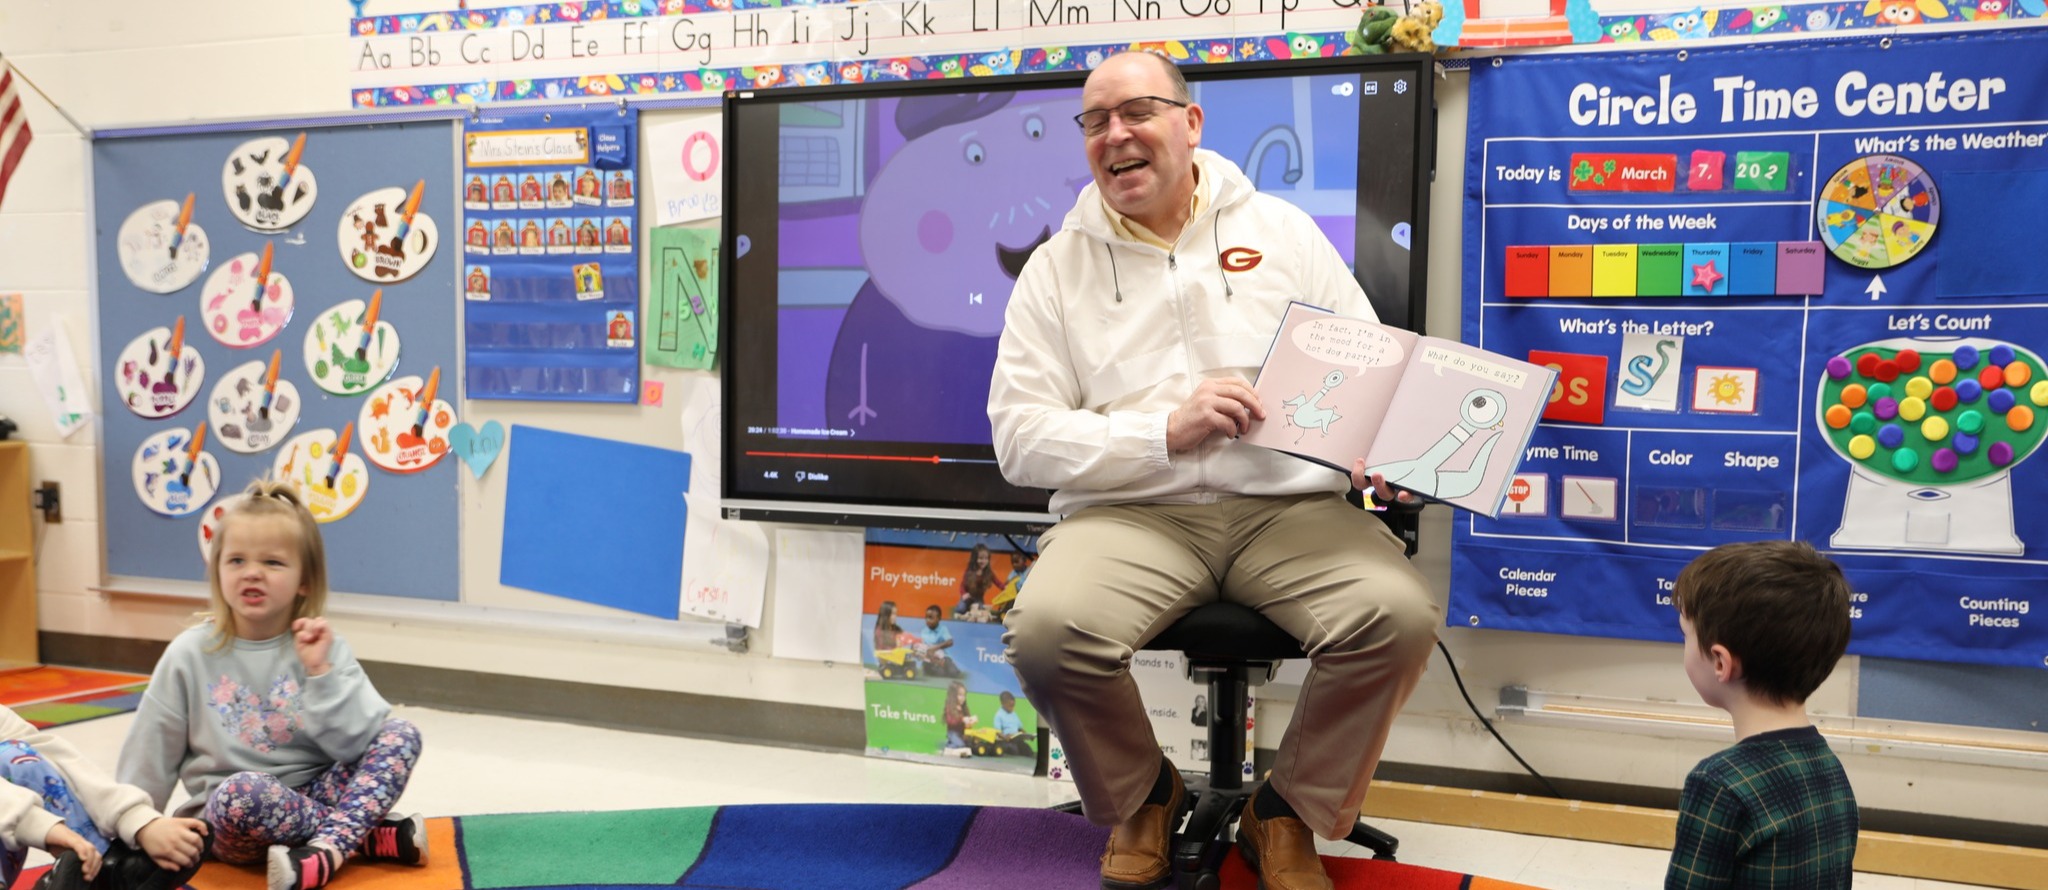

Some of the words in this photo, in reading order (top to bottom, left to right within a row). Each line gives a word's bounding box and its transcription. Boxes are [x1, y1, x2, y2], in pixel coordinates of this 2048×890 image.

[359, 41, 392, 70] Aa
[410, 36, 441, 67] Bb
[460, 33, 491, 64] Cc
[511, 28, 545, 61] Dd
[571, 25, 599, 57] Ee
[623, 21, 648, 54] Ff
[672, 18, 711, 66] Gg
[733, 13, 769, 47] Hh
[791, 9, 810, 43] Ii
[840, 6, 869, 55] Jj
[901, 1, 936, 37] Kk
[1029, 0, 1089, 27] Mm
[1569, 74, 1697, 126] Circle
[1714, 76, 1819, 122] Time
[1835, 71, 2006, 116] Center
[543, 136, 574, 155] Class
[1854, 134, 1920, 153] What's
[1925, 134, 1957, 150] the
[1496, 165, 1544, 183] Today
[1549, 166, 1561, 181] is
[1622, 167, 1666, 179] March
[1568, 215, 1608, 233] Days
[1613, 214, 1631, 229] of
[1636, 214, 1664, 229] the
[1668, 213, 1716, 229] Week
[1220, 246, 1263, 272] G
[1516, 252, 1539, 260] Sunday
[1558, 251, 1584, 260] Monday
[1602, 250, 1628, 259] Tuesday
[1641, 249, 1679, 259] Wednesday
[1691, 248, 1721, 258] Thursday
[1742, 248, 1763, 258] Friday
[1560, 318, 1616, 334] What's
[1621, 320, 1650, 335] the
[1652, 321, 1714, 336] Letter?
[1889, 314, 1929, 330] Let's
[1935, 314, 1991, 330] Count
[1312, 321, 1323, 330] In
[1357, 329, 1374, 338] I'm
[1378, 333, 1391, 343] in
[1309, 332, 1326, 342] the
[1356, 340, 1373, 351] for
[1305, 343, 1321, 353] hot
[1325, 347, 1341, 357] dog
[1344, 350, 1380, 365] party!
[1427, 350, 1448, 361] What
[1453, 357, 1466, 367] do
[1470, 363, 1489, 374] you
[1494, 370, 1520, 383] say?
[1526, 446, 1559, 462] yme
[1563, 446, 1598, 461] Time
[1649, 450, 1693, 465] Color
[1724, 452, 1779, 471] Shape
[807, 472, 829, 481] Dislike
[870, 566, 900, 587] Play
[902, 571, 956, 590] together
[1500, 568, 1556, 581] Calendar
[1506, 584, 1547, 597] Pieces
[1960, 597, 2029, 615] Counting
[1970, 611, 2021, 627] Pieces
[975, 647, 1006, 664] Trad
[1134, 658, 1162, 668] hands
[1164, 660, 1175, 669] to
[871, 703, 900, 720] Take
[903, 710, 937, 724] turns
[1150, 709, 1180, 719] inside.
